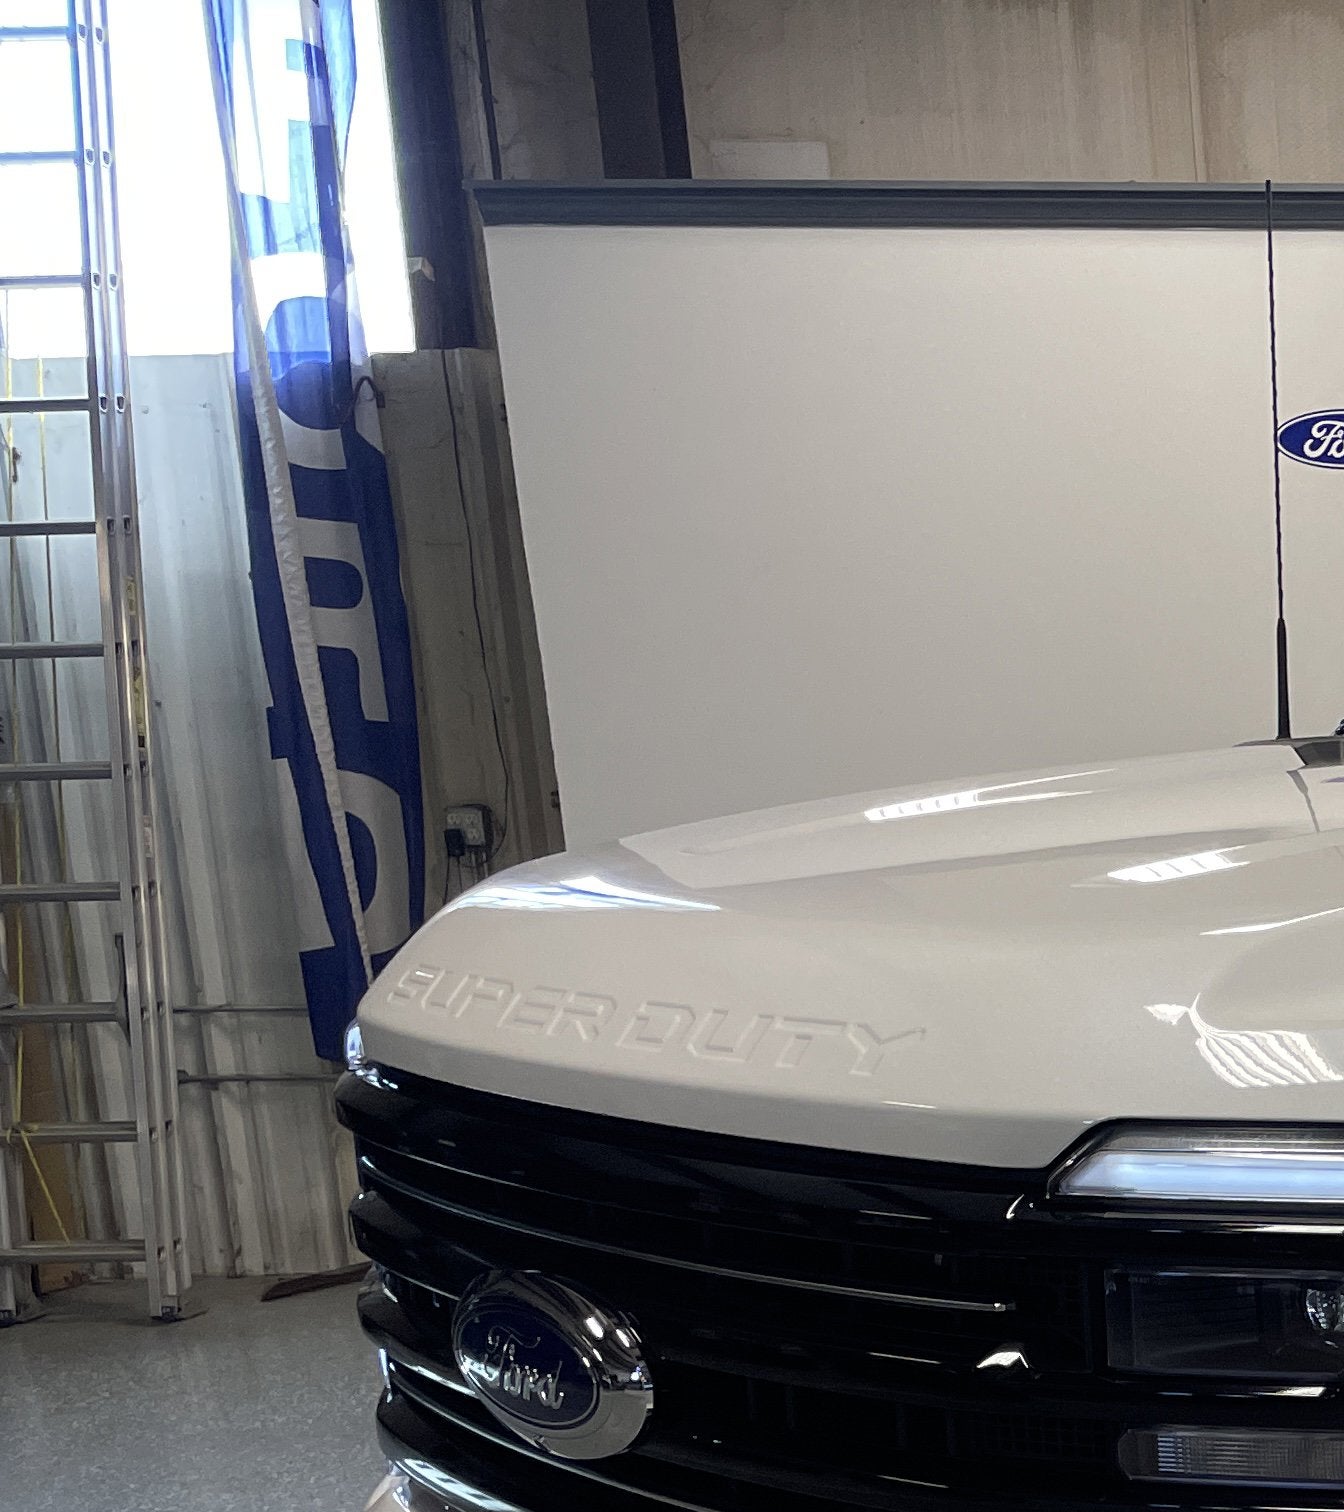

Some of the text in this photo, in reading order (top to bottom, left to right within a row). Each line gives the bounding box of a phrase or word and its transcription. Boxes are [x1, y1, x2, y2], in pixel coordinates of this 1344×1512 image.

[387, 963, 927, 1077] SUPER DUTY
[484, 1325, 565, 1410] Ford
